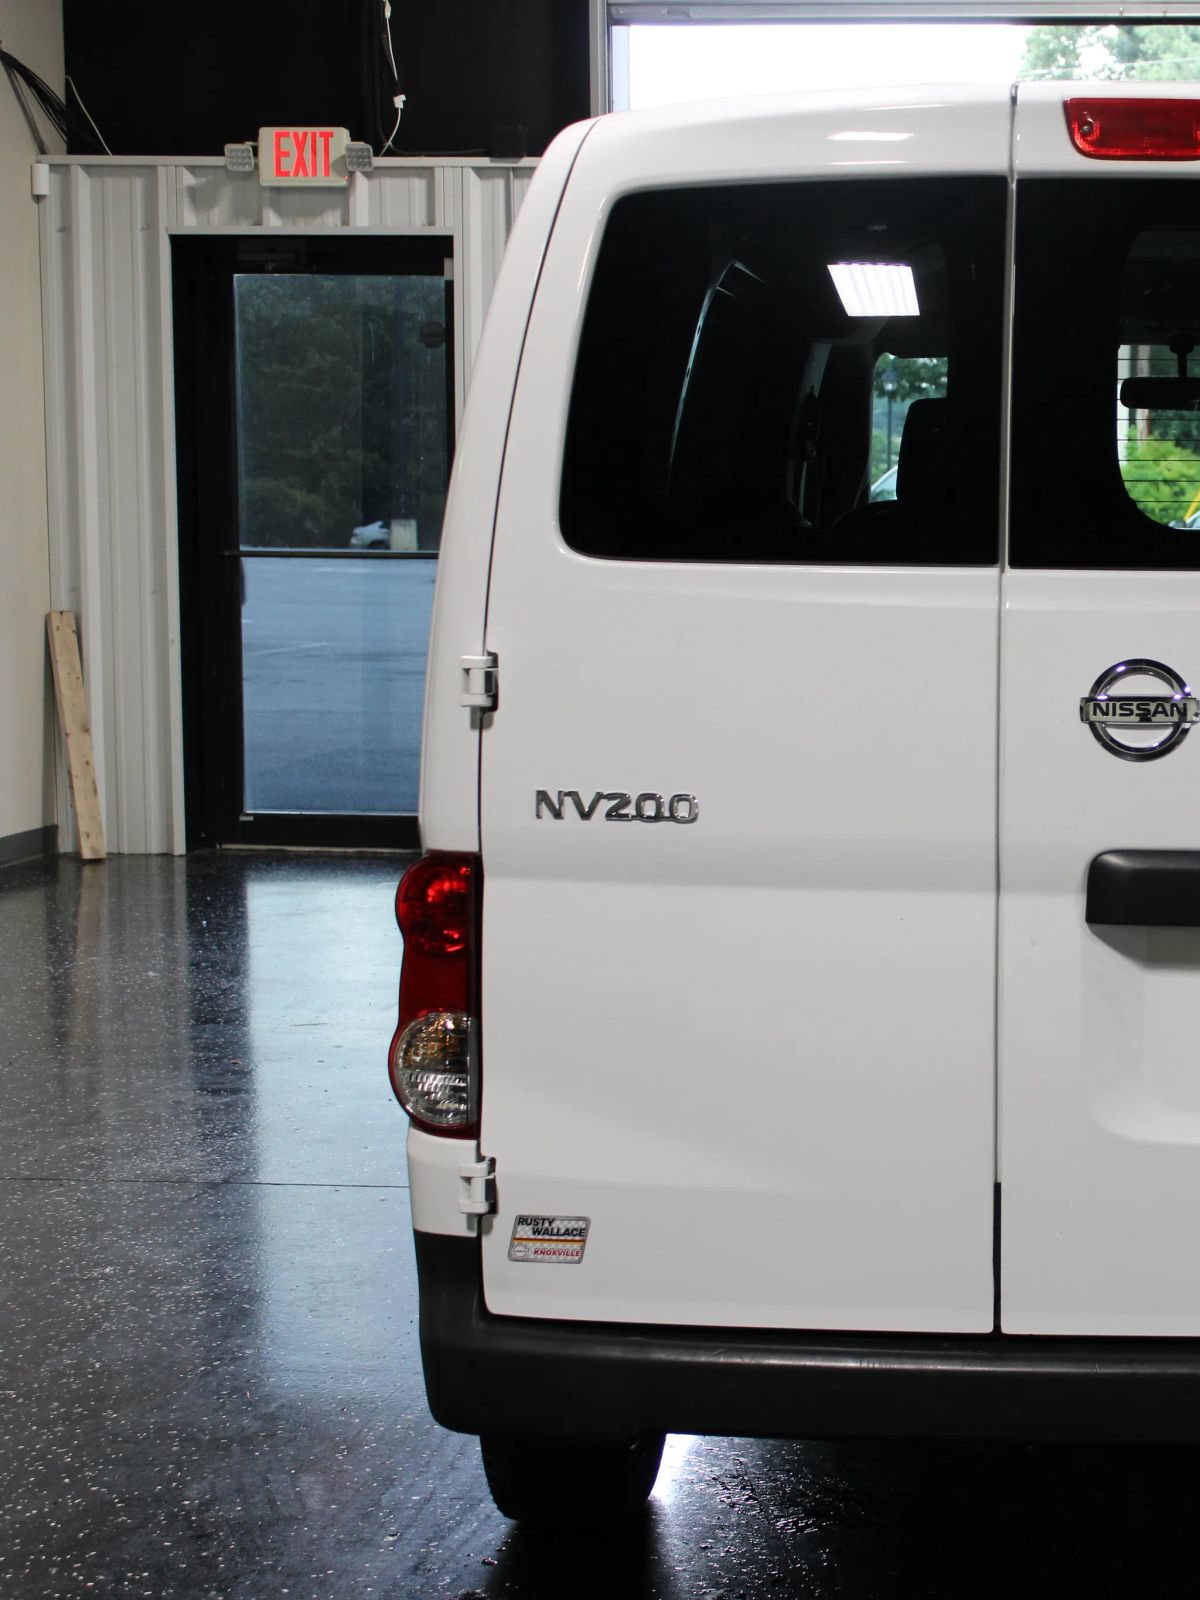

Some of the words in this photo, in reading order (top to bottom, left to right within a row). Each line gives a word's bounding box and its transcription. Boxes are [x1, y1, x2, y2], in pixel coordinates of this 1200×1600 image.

[273, 131, 334, 177] EXIT
[1092, 702, 1188, 718] NISSAN
[535, 789, 699, 824] NV200
[517, 1217, 555, 1226] RUSTY
[532, 1227, 586, 1237] WALLACE
[533, 1248, 581, 1257] KNOXVILLE
